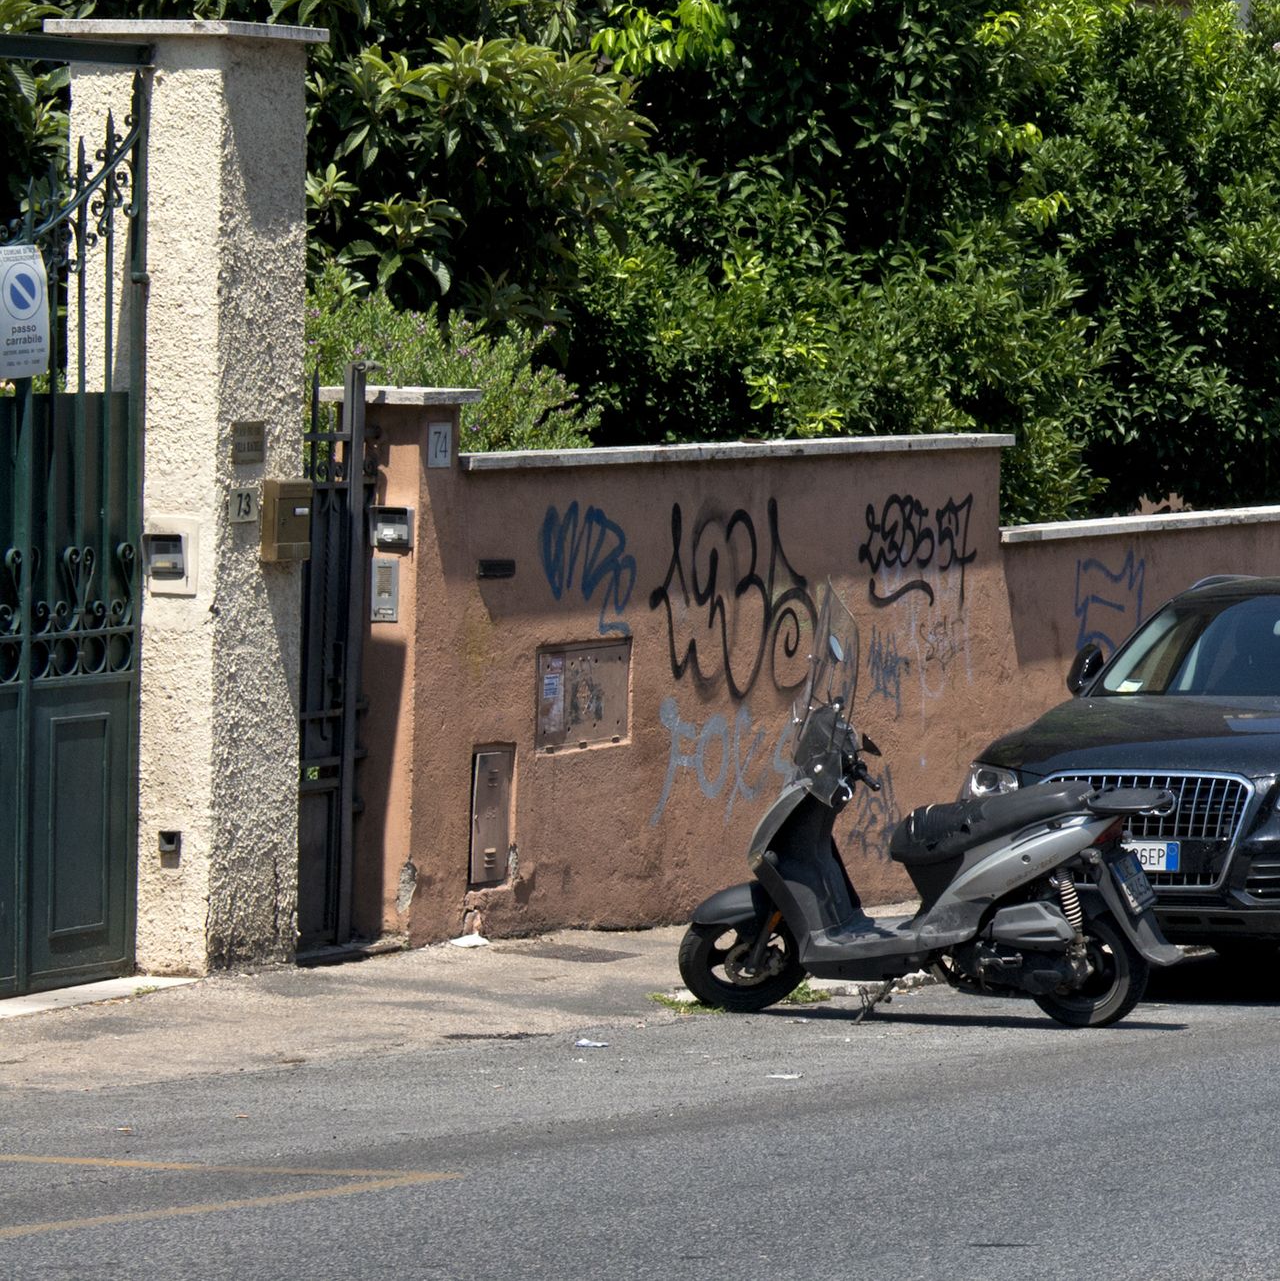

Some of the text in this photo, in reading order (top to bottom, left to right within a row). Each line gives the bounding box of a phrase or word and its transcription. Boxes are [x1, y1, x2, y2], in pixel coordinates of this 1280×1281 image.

[11, 324, 37, 336] passo
[5, 335, 43, 346] carrabile
[433, 431, 449, 459] 74
[236, 492, 252, 517] 73
